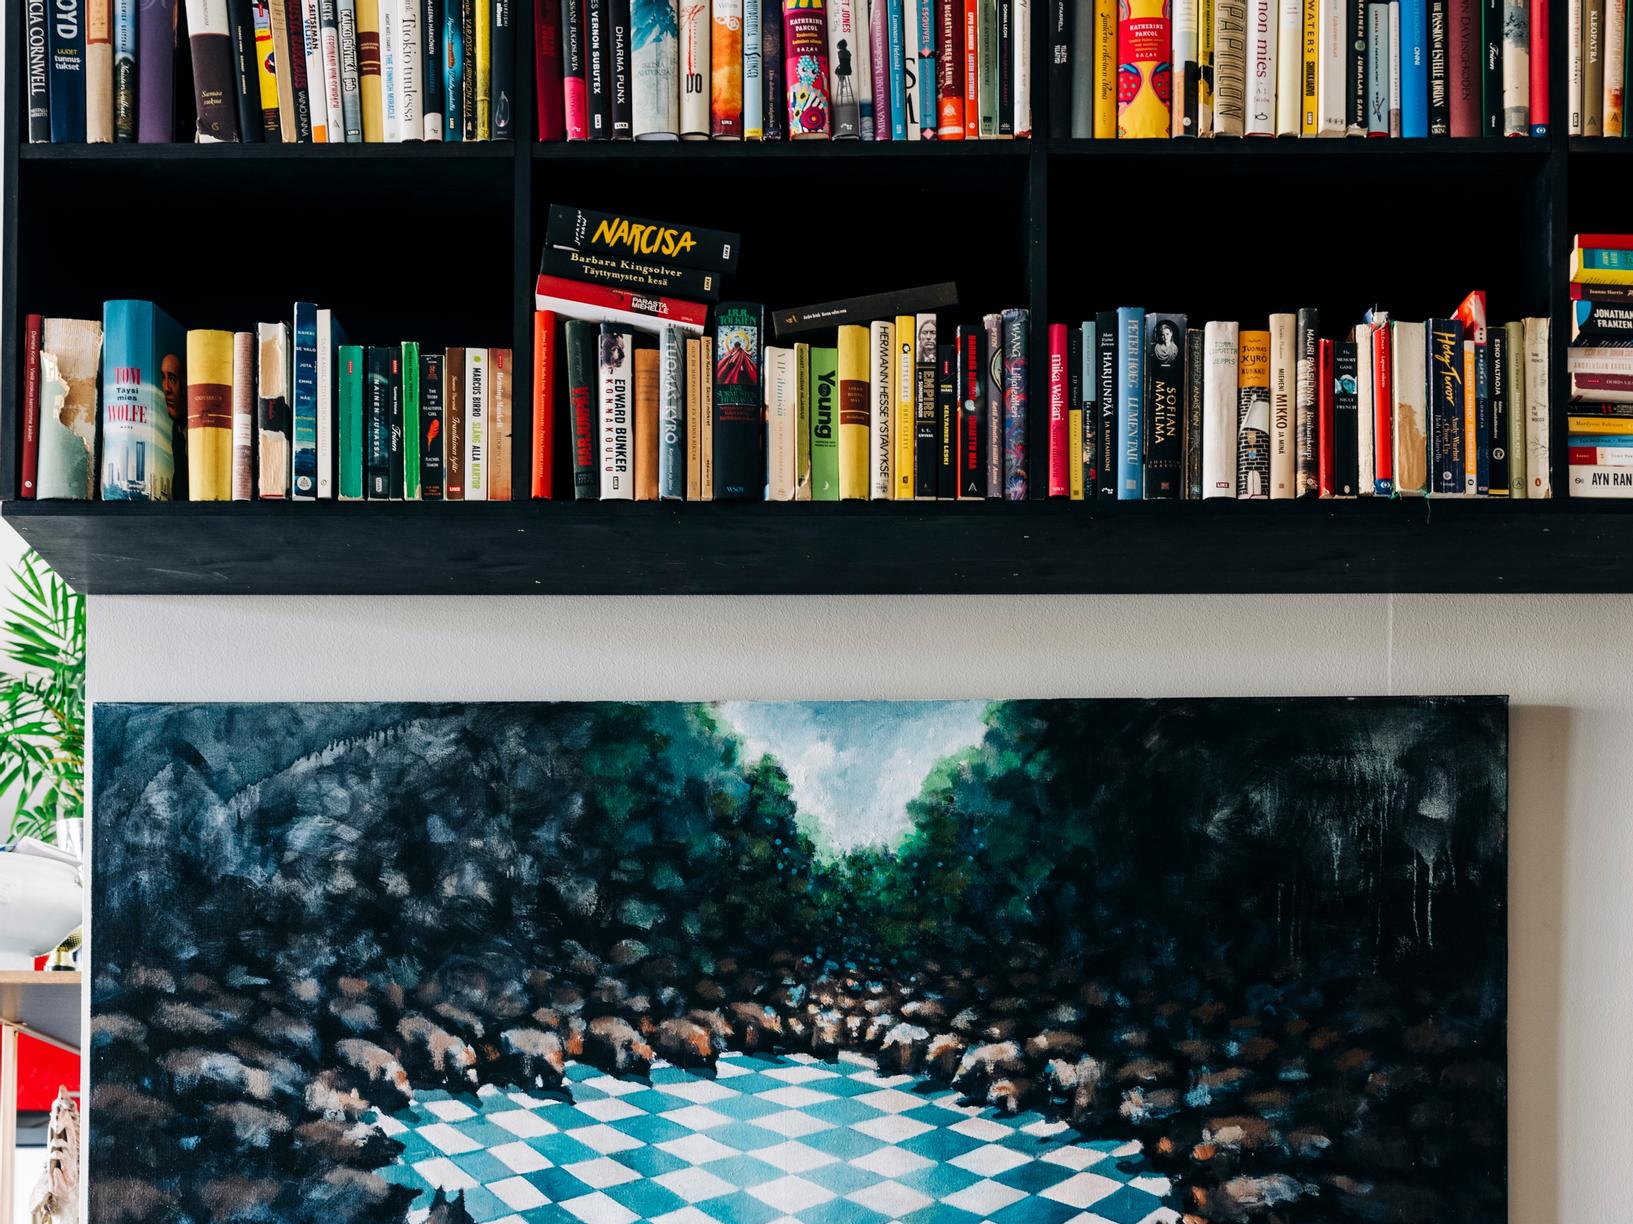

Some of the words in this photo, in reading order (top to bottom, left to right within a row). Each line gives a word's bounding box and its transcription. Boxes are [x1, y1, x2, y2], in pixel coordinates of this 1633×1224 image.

[56, 0, 78, 39] OYD
[340, 10, 353, 37] KAUKO
[591, 11, 599, 49] VERNON
[789, 18, 823, 26] KATHERINE
[841, 8, 851, 33] JONES
[1129, 23, 1164, 31] KATHERINE
[1307, 0, 1315, 54] WATERS
[1432, 12, 1444, 42] PASSION
[1590, 10, 1598, 63] KLEOPATRA
[342, 38, 357, 72] RÖYHKÄ
[402, 14, 417, 64] Tuokio
[615, 26, 624, 72] DHARMA
[30, 27, 46, 96] CORNWELL
[592, 51, 601, 94] SUBUTEX
[1217, 3, 1245, 119] PAPILLON
[1256, 39, 1272, 78] mies
[1432, 49, 1444, 79] ESTELLE
[343, 77, 356, 92] job
[403, 67, 417, 122] tuulessa
[616, 74, 625, 104] PUNX
[1431, 79, 1444, 107] JORDAN
[591, 217, 697, 258] NARCISA
[570, 252, 617, 267] Barbara
[620, 260, 683, 278] Kingsolver
[582, 265, 645, 283] Täyttymysten
[648, 275, 668, 287] kesä
[631, 302, 670, 315] MIEHELLE
[632, 296, 668, 309] PARASTA
[719, 315, 757, 326] TOLKIEN
[1010, 322, 1022, 358] WANG
[1127, 319, 1139, 355] PETER
[1306, 328, 1314, 355] MAURI
[1597, 319, 1633, 329] FRANZEN
[879, 326, 889, 378] HERMANN
[1051, 353, 1064, 380] mika
[1240, 354, 1267, 366] KYRÖ
[1432, 331, 1457, 368] Holy
[113, 367, 141, 385] TOM
[472, 367, 481, 394] MARCUS
[664, 341, 677, 400] TUOMAS
[1101, 352, 1114, 417] HARJUNPÄÄ
[1306, 356, 1314, 406] PAASILINNA
[1440, 366, 1462, 406] Terror
[472, 396, 481, 417] BIRRO
[614, 379, 626, 424] EDWARD
[814, 370, 836, 439] Young
[880, 386, 889, 416] HESSE
[923, 371, 934, 418] EMPIRE
[1007, 367, 1022, 418] Liljateatteri
[1051, 380, 1065, 421] waltari
[107, 404, 147, 424] WOLFE
[605, 378, 614, 472] KONNAKOULU
[664, 405, 679, 444] KYRÖ
[1127, 397, 1139, 437] LUMEN
[1154, 380, 1166, 444] MAAILMA
[1166, 387, 1177, 437] SOFIAN
[1276, 393, 1287, 429] MIKKO
[391, 424, 401, 452] Toinen
[472, 445, 481, 461] ALLA
[615, 427, 627, 473] BUNKER
[1126, 439, 1138, 465] TAJU
[1591, 472, 1610, 486] AYN
